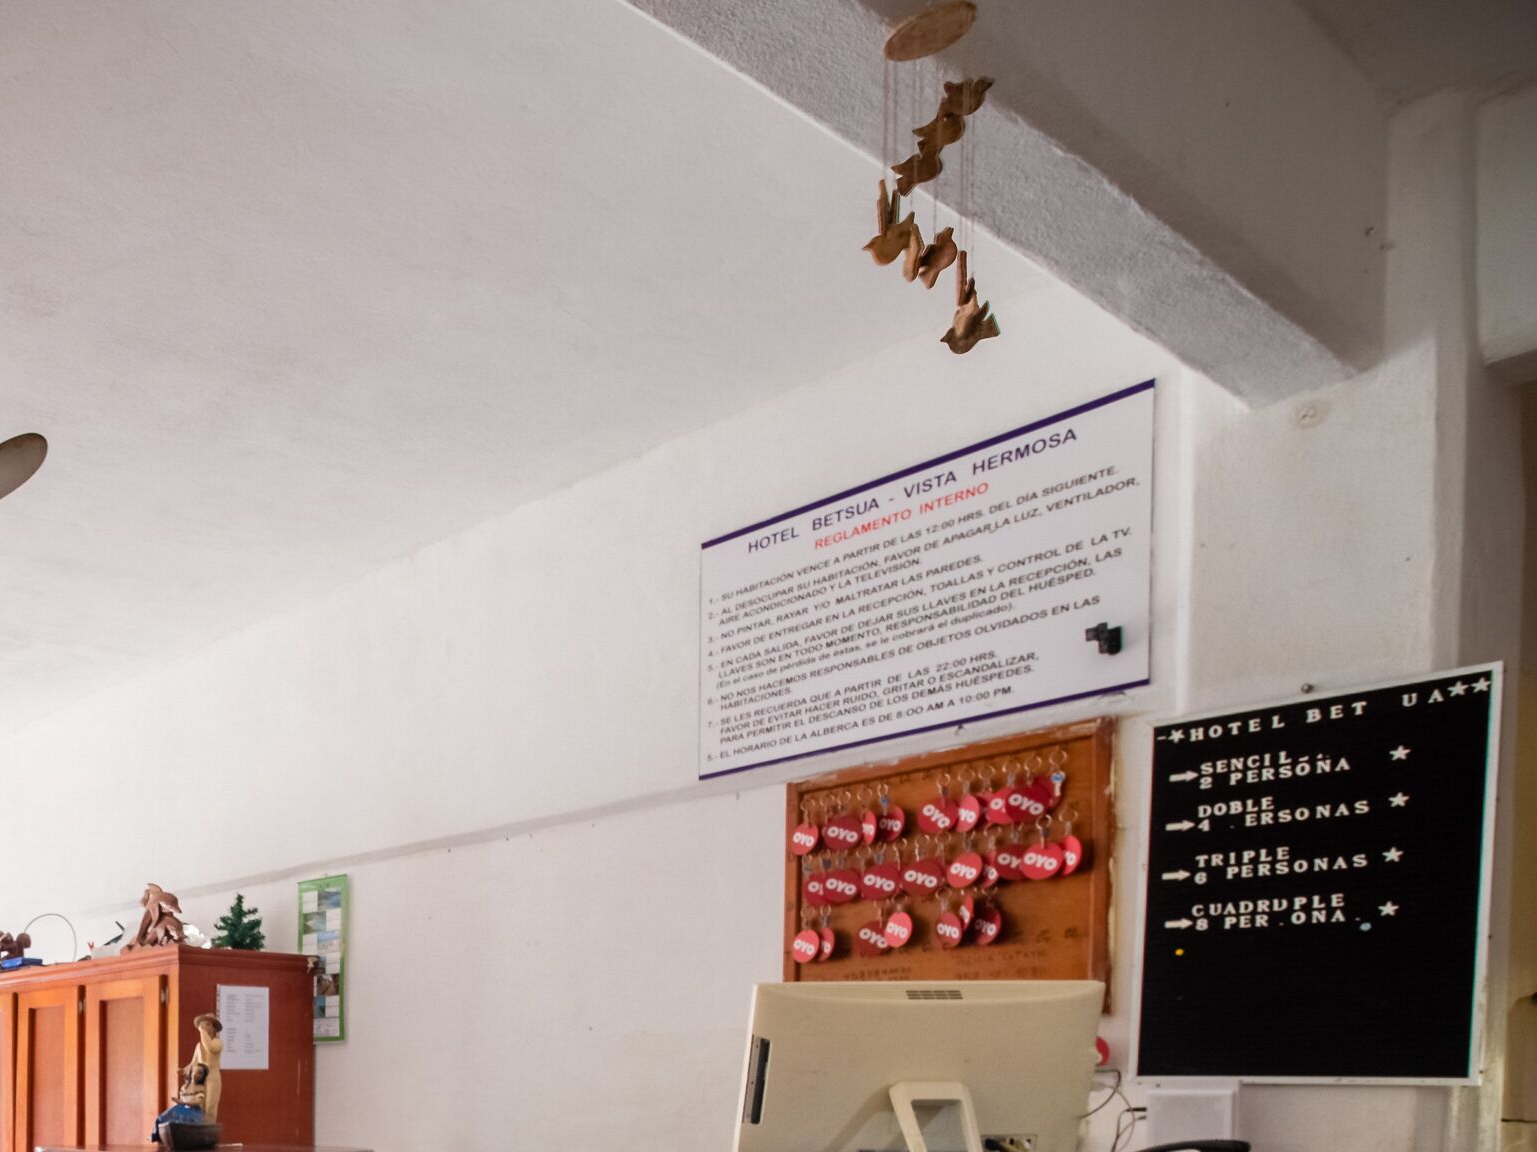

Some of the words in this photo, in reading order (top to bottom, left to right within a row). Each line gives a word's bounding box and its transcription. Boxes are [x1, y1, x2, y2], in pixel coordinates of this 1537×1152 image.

[748, 527, 799, 553] HOTEL
[812, 497, 879, 531] BETSUA
[903, 470, 957, 498] VISTA
[972, 428, 1077, 475] HERMOSA
[814, 508, 912, 550] REGLAMENTO
[919, 482, 989, 514] INTERNO
[721, 591, 734, 601] SU
[796, 559, 830, 576] VENCE
[833, 556, 840, 564] A
[842, 543, 880, 561] PARTIR
[882, 537, 897, 549] DE
[900, 529, 922, 543] LAS
[925, 518, 955, 534] 12:00
[988, 500, 1012, 514] DEL
[721, 607, 732, 615] AL
[734, 585, 794, 611] DESOCUPAR
[796, 580, 810, 591] SU
[883, 545, 921, 564] FAVOR
[923, 539, 939, 552] DE
[942, 523, 992, 545] APAGAR
[994, 517, 1011, 530] LA
[718, 613, 740, 626] AIRE
[742, 586, 827, 618] ACONDICIONADO
[829, 583, 835, 591] Y
[838, 578, 852, 589] LA
[720, 639, 751, 653] FAVOR
[753, 634, 766, 644] DE
[768, 617, 823, 640] ENTREGAR
[825, 612, 839, 623] EN
[841, 608, 855, 619] LA
[930, 570, 984, 592] TOALLAS
[987, 567, 994, 576] Y
[997, 548, 1061, 573] CONTROL
[1065, 540, 1083, 554] DE
[1090, 534, 1108, 546] LA
[720, 629, 735, 639] NO
[776, 606, 808, 622] RAYAR
[835, 579, 898, 605] MALTRATAR
[901, 572, 923, 586] LAS
[720, 658, 733, 668] EN
[735, 650, 762, 664] CADA
[804, 628, 838, 644] FAVOR
[840, 623, 854, 634] DE
[857, 612, 893, 630] DEJAR
[896, 605, 919, 619] SUS
[922, 591, 967, 611] LLAVES
[969, 586, 986, 598] EN
[989, 581, 1006, 592] LA
[1095, 547, 1122, 563] LAS
[718, 662, 753, 679] LLAVES
[755, 656, 776, 668] SON
[778, 652, 792, 662] EN
[794, 642, 823, 657] TODO
[885, 594, 997, 632] RESPONSABILIDAD
[1000, 587, 1024, 601] DEL
[720, 692, 734, 701] NO
[736, 686, 756, 697] NOS
[758, 672, 807, 691] HACEMOS
[809, 649, 895, 678] RESPONSABLES
[897, 644, 913, 656] DE
[915, 629, 972, 651] OBJETOS
[974, 609, 1048, 635] OLVIDADOS
[1051, 603, 1070, 615] EN
[1073, 595, 1100, 610] LAS
[720, 716, 731, 726] SE
[734, 711, 752, 722] LES
[753, 697, 807, 717] RECUERDA
[809, 690, 831, 703] QUE
[833, 689, 842, 697] A
[843, 678, 882, 695] PARTIR
[887, 673, 901, 684] DE
[907, 666, 930, 679] LAS
[935, 657, 967, 673] 22:00
[720, 721, 750, 735] FAVOR
[752, 717, 765, 727] DE
[767, 708, 802, 723] EVITAR
[804, 699, 840, 714] HACER
[882, 678, 925, 696] GRITAR
[927, 676, 936, 685] O
[719, 750, 730, 759] EL
[733, 739, 777, 755] HORARIO
[778, 735, 792, 745] DE
[794, 732, 807, 742] LA
[809, 720, 859, 738] ALBERCA
[861, 716, 875, 727] ES
[878, 712, 892, 723] DE
[926, 701, 944, 711] AM
[946, 698, 955, 707] A
[958, 690, 990, 704] 10:00
[720, 732, 744, 744] PARA
[746, 721, 791, 738] PERMITIR
[793, 718, 805, 727] EL
[808, 703, 867, 724] DESCANSO
[869, 699, 883, 709] DE
[886, 693, 909, 705] LOS
[1189, 715, 1285, 742] HOTEL
[1199, 776, 1212, 789] 2
[1229, 757, 1350, 786] PERSONA
[922, 804, 950, 828] OYO
[1008, 793, 1044, 815] OYO
[1198, 796, 1274, 818] DOBLE
[1198, 819, 1210, 832] 4
[1229, 800, 1370, 829] ERSONAS
[793, 831, 815, 847] OYO
[827, 826, 858, 842] OYO
[950, 862, 976, 879] OYO
[1023, 852, 1057, 870] OYO
[1194, 872, 1207, 885] 6
[1226, 854, 1368, 879] PERSONAS
[1195, 846, 1290, 868] TRIPLE
[825, 878, 857, 895] OYO
[863, 874, 896, 892] OYO
[904, 870, 938, 888] OYO
[859, 928, 888, 949] OYO
[886, 921, 908, 939] OYO
[937, 923, 959, 939] OYO
[1195, 918, 1209, 931] 8
[793, 939, 815, 955] OYO
